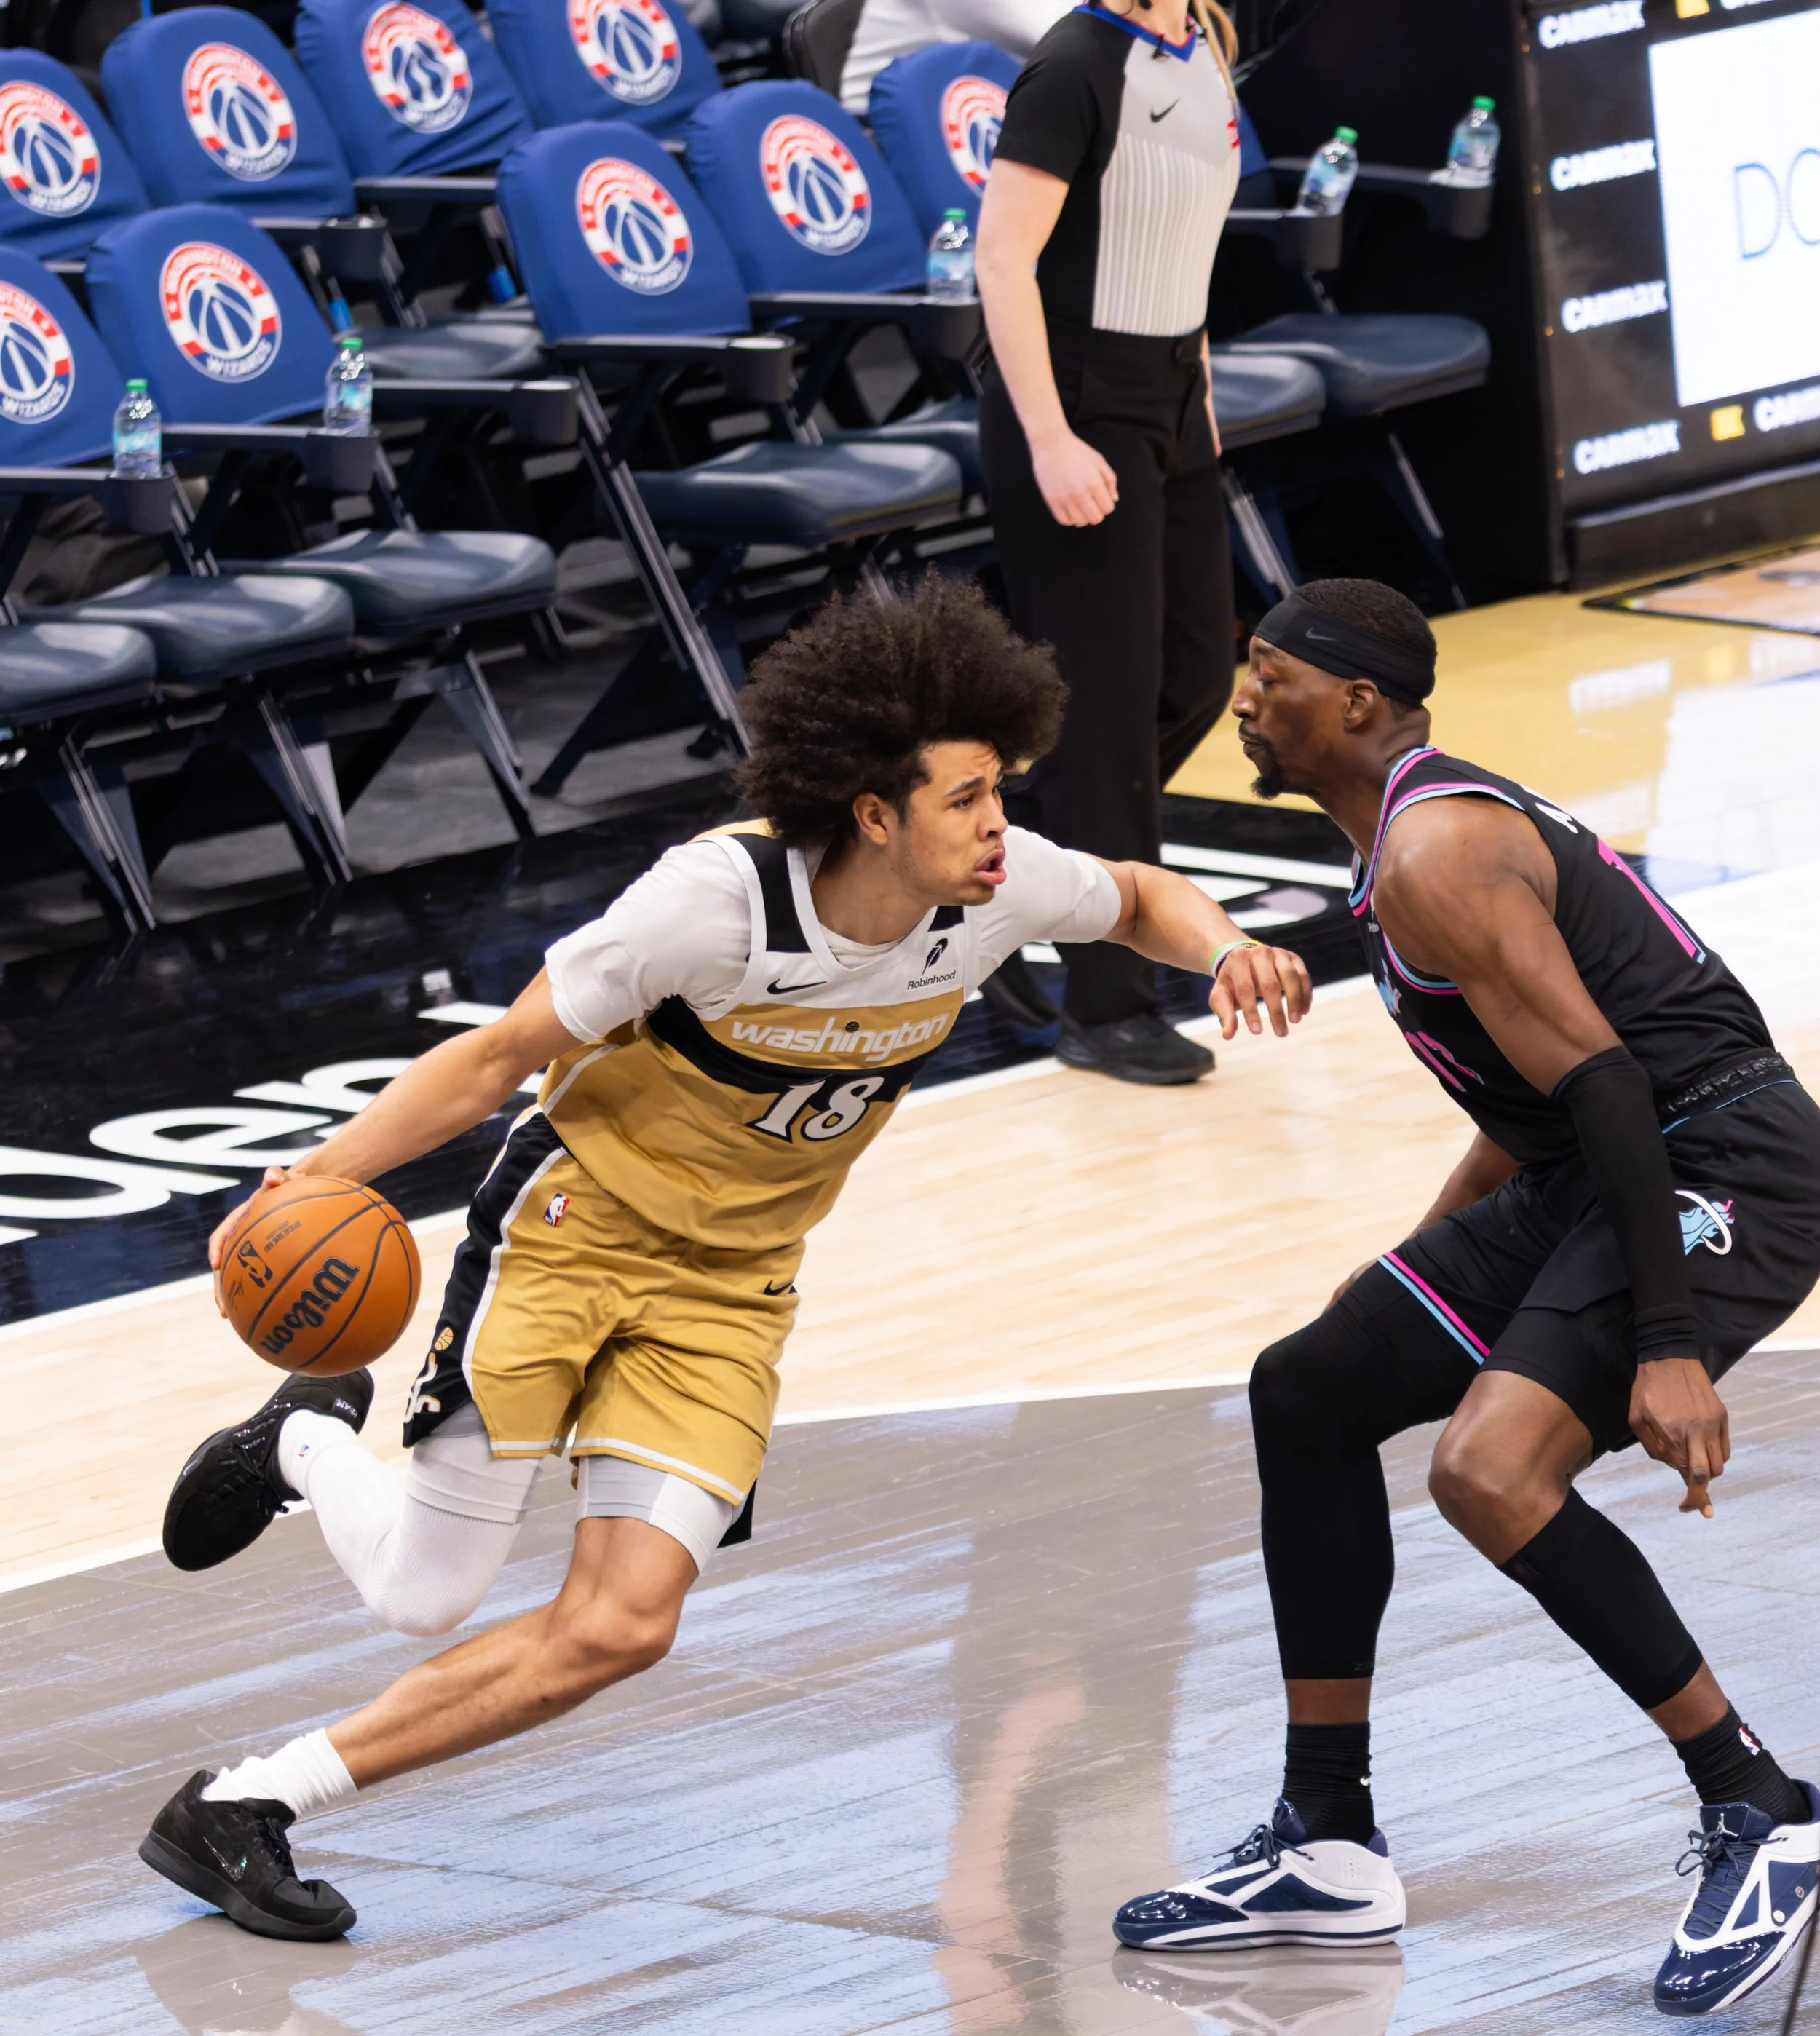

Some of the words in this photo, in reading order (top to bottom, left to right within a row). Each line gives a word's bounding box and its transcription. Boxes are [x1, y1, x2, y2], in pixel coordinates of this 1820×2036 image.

[906, 970, 956, 990] Robinhood
[732, 1012, 951, 1062] washington
[750, 1076, 886, 1143] 18
[260, 1256, 361, 1355] Wilson
